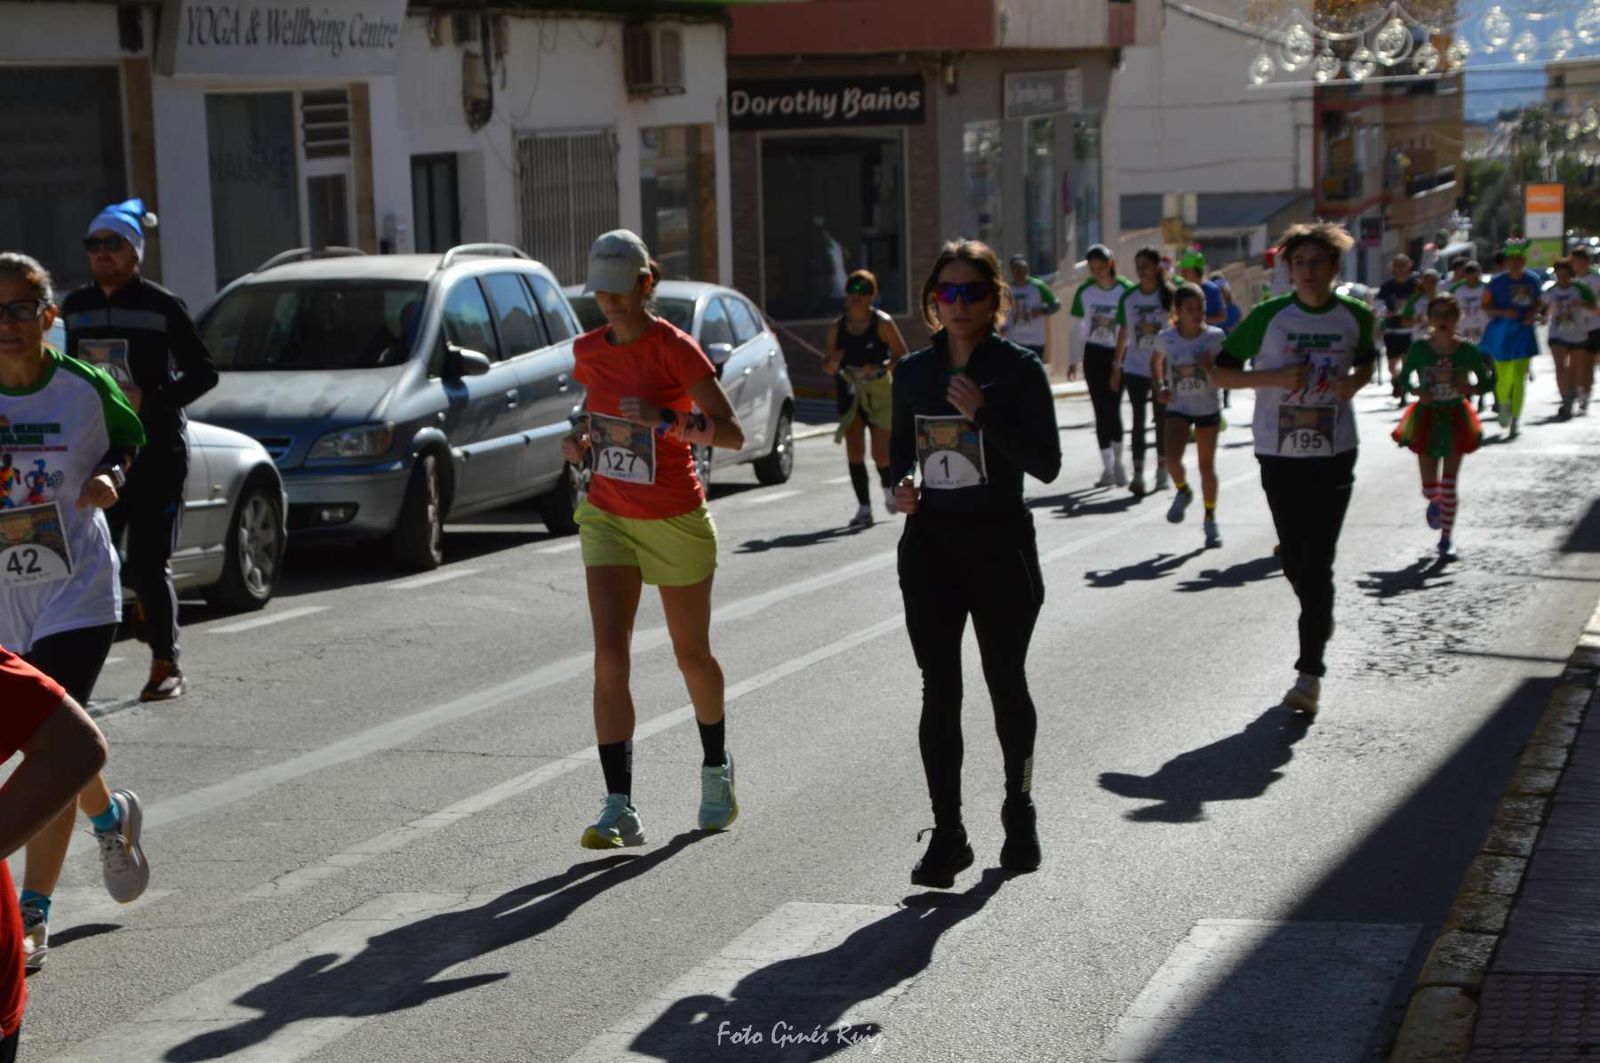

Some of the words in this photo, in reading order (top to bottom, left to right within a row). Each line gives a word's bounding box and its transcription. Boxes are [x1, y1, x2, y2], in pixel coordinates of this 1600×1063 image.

[187, 6, 241, 45] YOGA
[245, 7, 261, 45] &
[266, 7, 346, 57] Wellbeing
[349, 11, 398, 48] Centre
[731, 87, 838, 119] Dorothy
[842, 86, 921, 119] Baños
[1290, 431, 1322, 449] 195
[603, 449, 637, 473] 127
[939, 455, 951, 479] 1
[6, 548, 42, 575] 42
